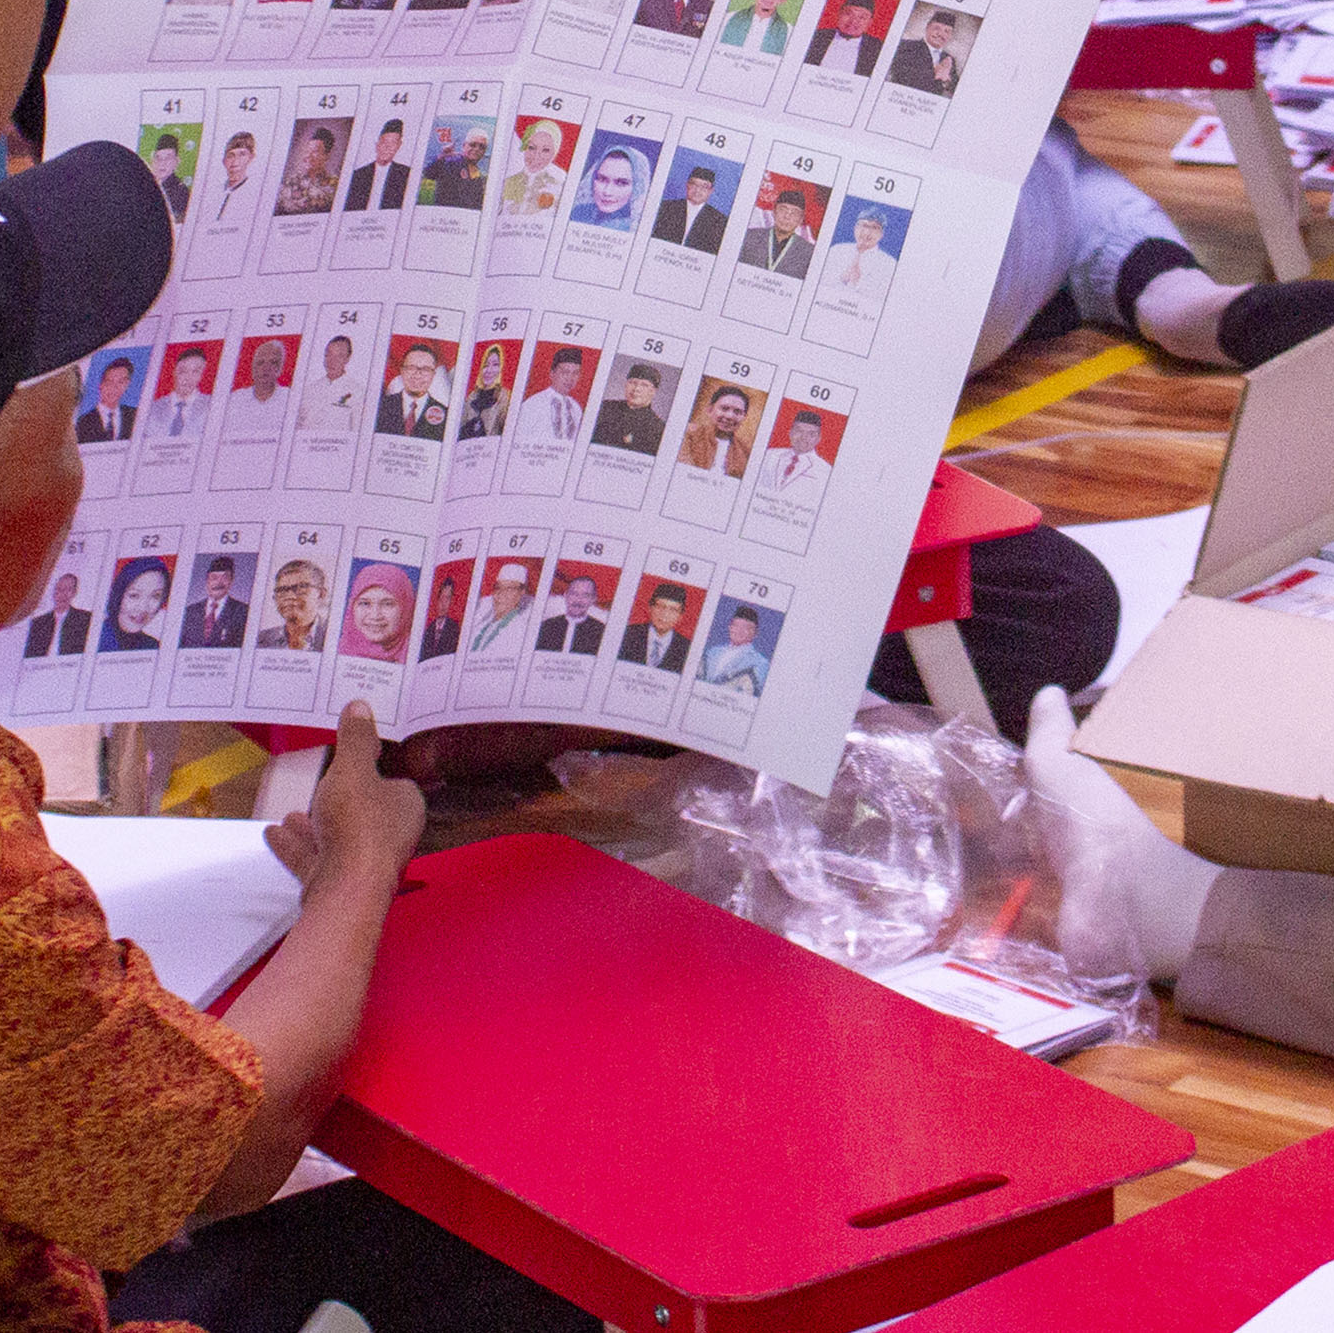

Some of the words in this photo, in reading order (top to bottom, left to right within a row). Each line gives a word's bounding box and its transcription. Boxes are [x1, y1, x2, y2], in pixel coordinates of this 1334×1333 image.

[238, 96, 259, 113] 42
[318, 94, 339, 110] 43
[389, 91, 410, 107] 44
[459, 89, 479, 104] 45
[541, 96, 563, 112] 46
[162, 99, 183, 115] 41
[623, 114, 646, 129] 47
[704, 133, 727, 149] 48
[792, 156, 815, 172] 49
[873, 177, 896, 193] 50
[266, 314, 286, 327] 53
[338, 310, 359, 325] 54
[416, 314, 439, 329] 55
[190, 319, 209, 333] 52
[563, 322, 585, 338] 57
[642, 338, 665, 355] 58
[729, 362, 752, 378] 59
[809, 384, 832, 401] 60
[140, 534, 160, 550] 62
[219, 530, 240, 545] 63
[297, 531, 319, 546] 64
[508, 534, 528, 550] 67
[67, 540, 85, 555] 61
[378, 539, 402, 555] 65
[583, 541, 605, 557] 68
[669, 560, 691, 575] 69
[748, 582, 770, 598] 70
